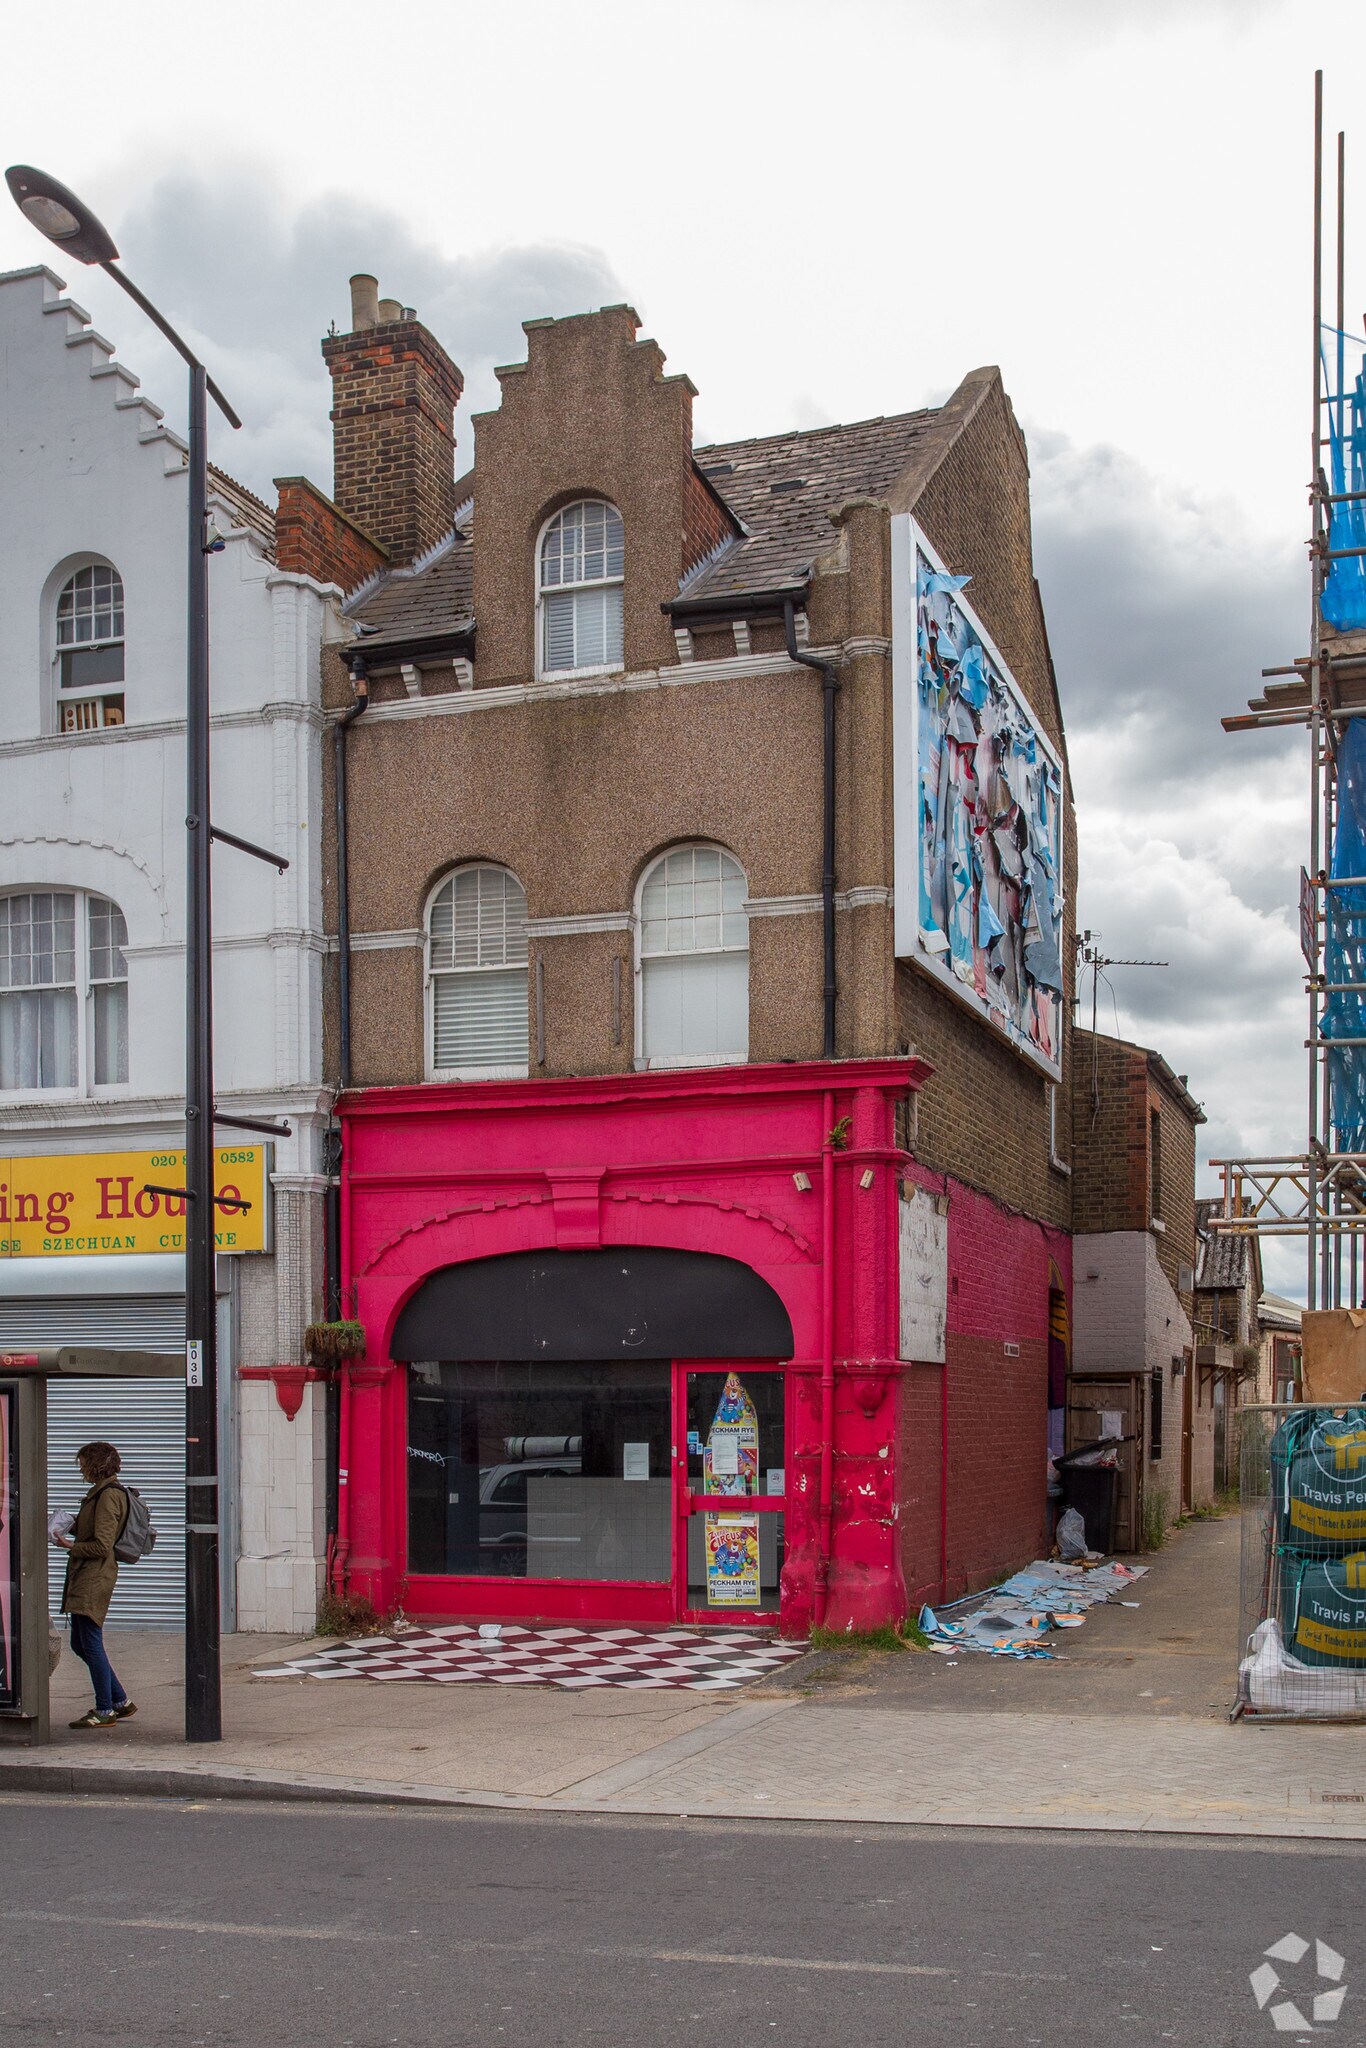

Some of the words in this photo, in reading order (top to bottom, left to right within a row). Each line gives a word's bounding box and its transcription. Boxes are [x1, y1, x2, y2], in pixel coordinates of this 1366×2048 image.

[151, 1155, 177, 1167] 020
[220, 1151, 255, 1164] 0582
[95, 1176, 242, 1219] Houe
[42, 1236, 136, 1251] SZECHUAN
[159, 1233, 237, 1247] CUNE
[1301, 1482, 1342, 1504] Travis
[709, 1531, 741, 1552] CIRCUS
[1311, 1599, 1351, 1623] Travis
